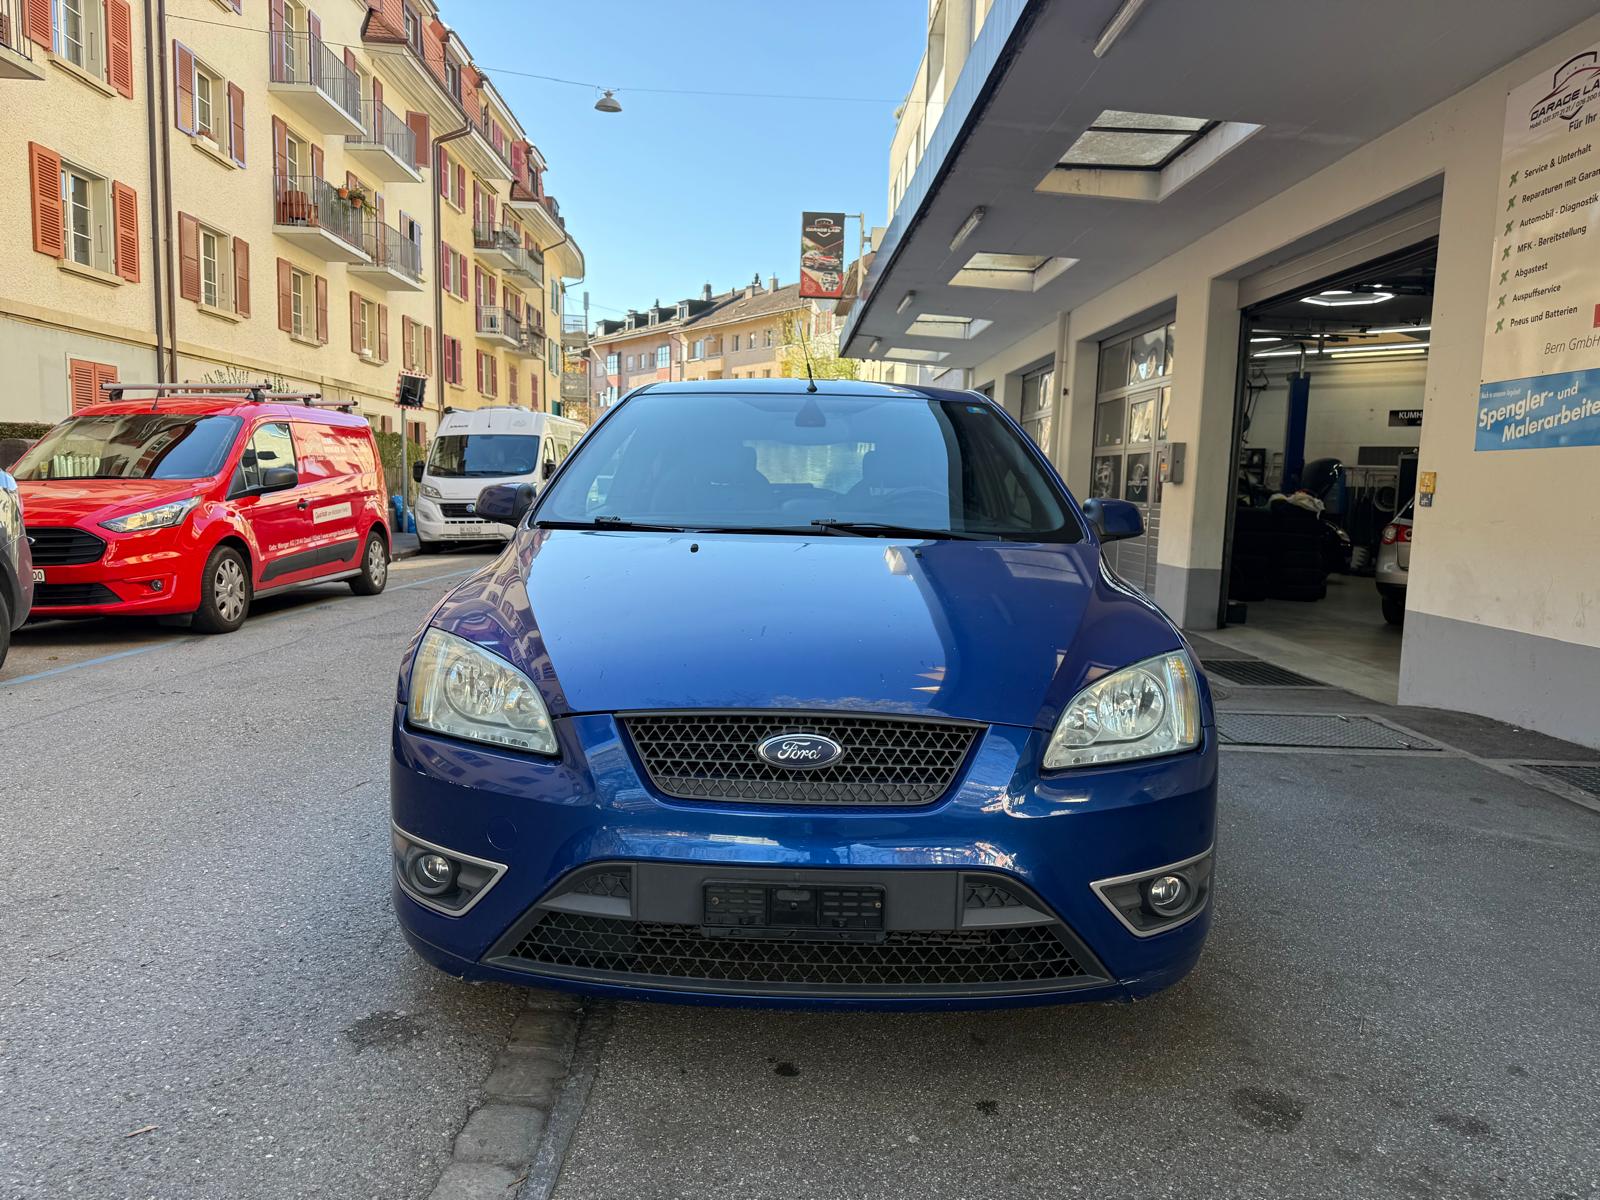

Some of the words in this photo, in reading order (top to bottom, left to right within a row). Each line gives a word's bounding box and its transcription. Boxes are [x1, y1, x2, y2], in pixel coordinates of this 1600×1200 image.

[1531, 88, 1580, 121] GARAGE
[1569, 118, 1583, 132] Für
[1585, 113, 1597, 125] Ihr
[1524, 163, 1548, 178] Service
[1549, 158, 1555, 168] &
[1557, 144, 1591, 165] Unterhalt
[1522, 182, 1562, 204] Reparaturen
[1565, 176, 1576, 187] mit
[1519, 209, 1554, 228] Automobil
[1560, 193, 1598, 214] Diagnostik
[1517, 241, 1533, 253] MFK
[1538, 225, 1587, 247] Bereitstellung
[1514, 262, 1548, 278] Abgastest
[1512, 284, 1561, 303] Auspuffservice
[1510, 315, 1529, 328] Pneus
[1530, 312, 1543, 323] und
[1545, 305, 1578, 320] Batterien
[1544, 340, 1565, 355] Bern
[1569, 335, 1600, 351] GmbH
[1479, 389, 1554, 430] Spengler-
[1557, 380, 1579, 400] und
[777, 741, 821, 759] Ford
